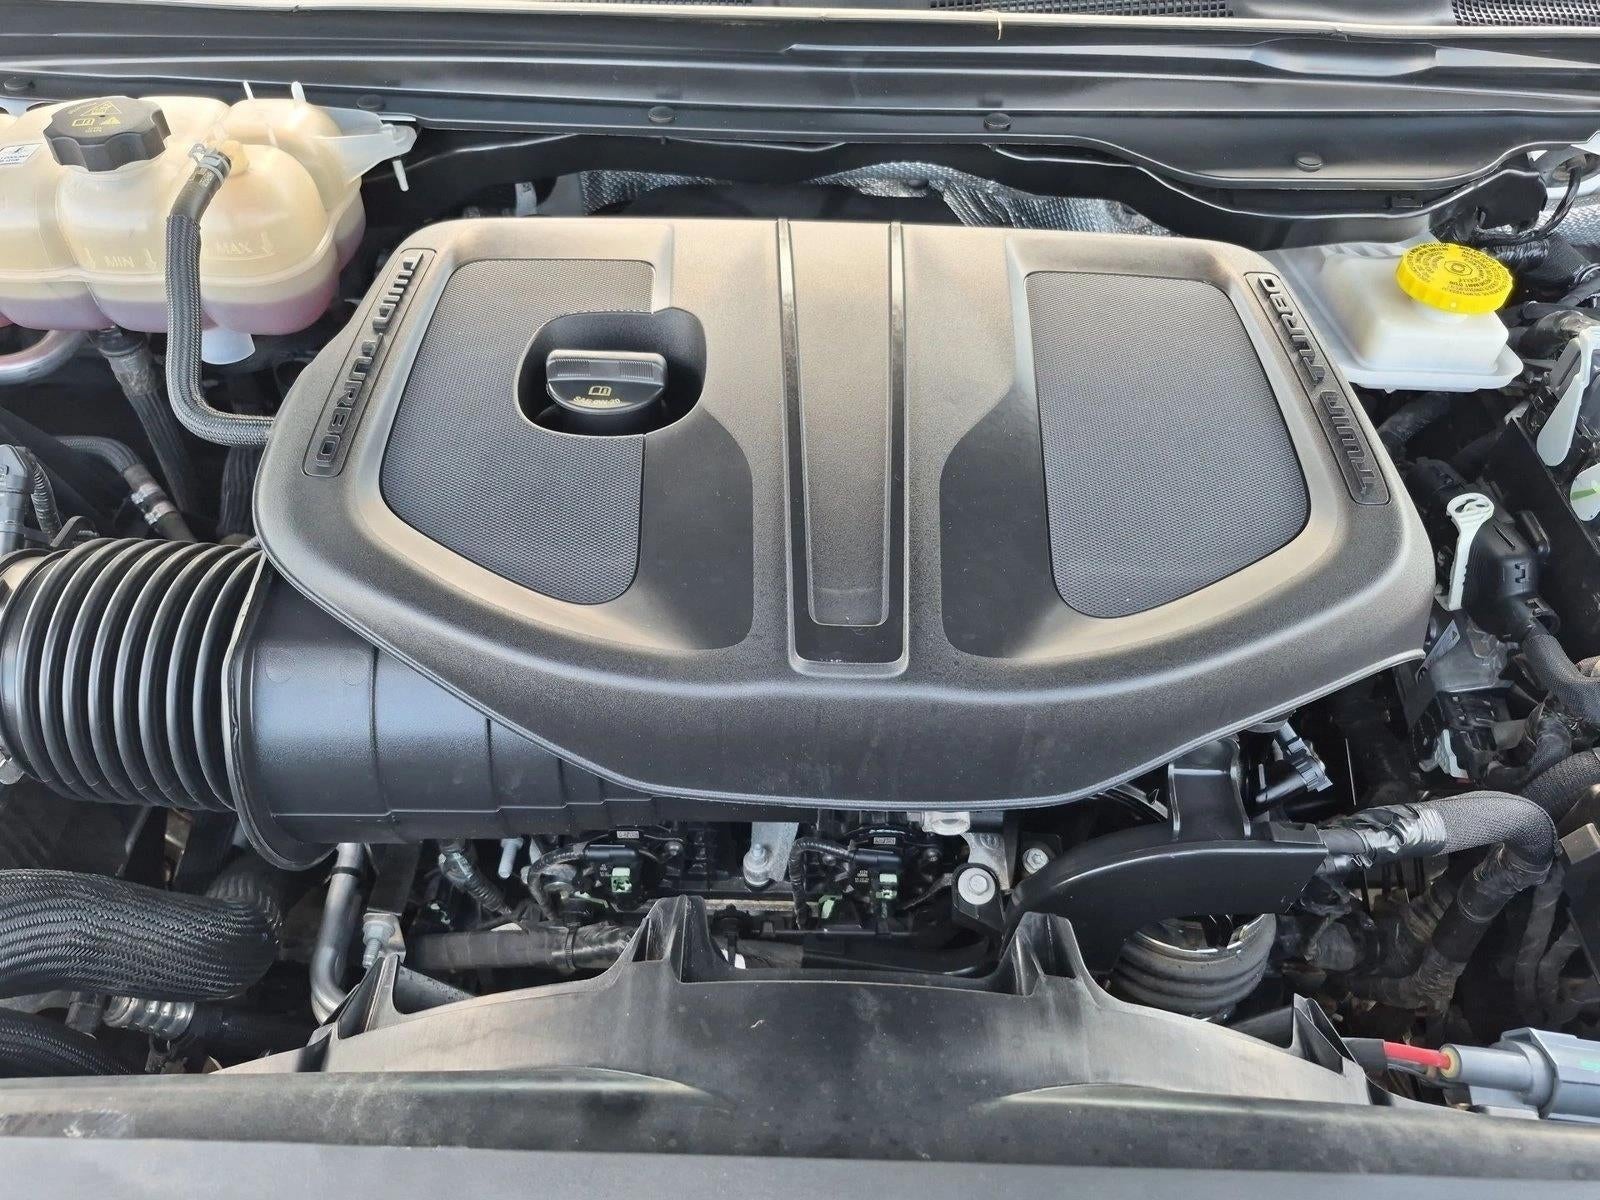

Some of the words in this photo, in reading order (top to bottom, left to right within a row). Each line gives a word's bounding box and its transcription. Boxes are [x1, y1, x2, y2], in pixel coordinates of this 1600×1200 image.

[1257, 274, 1326, 387] TURBO
[314, 332, 384, 467] TURBO
[1319, 390, 1378, 495] TWIN
